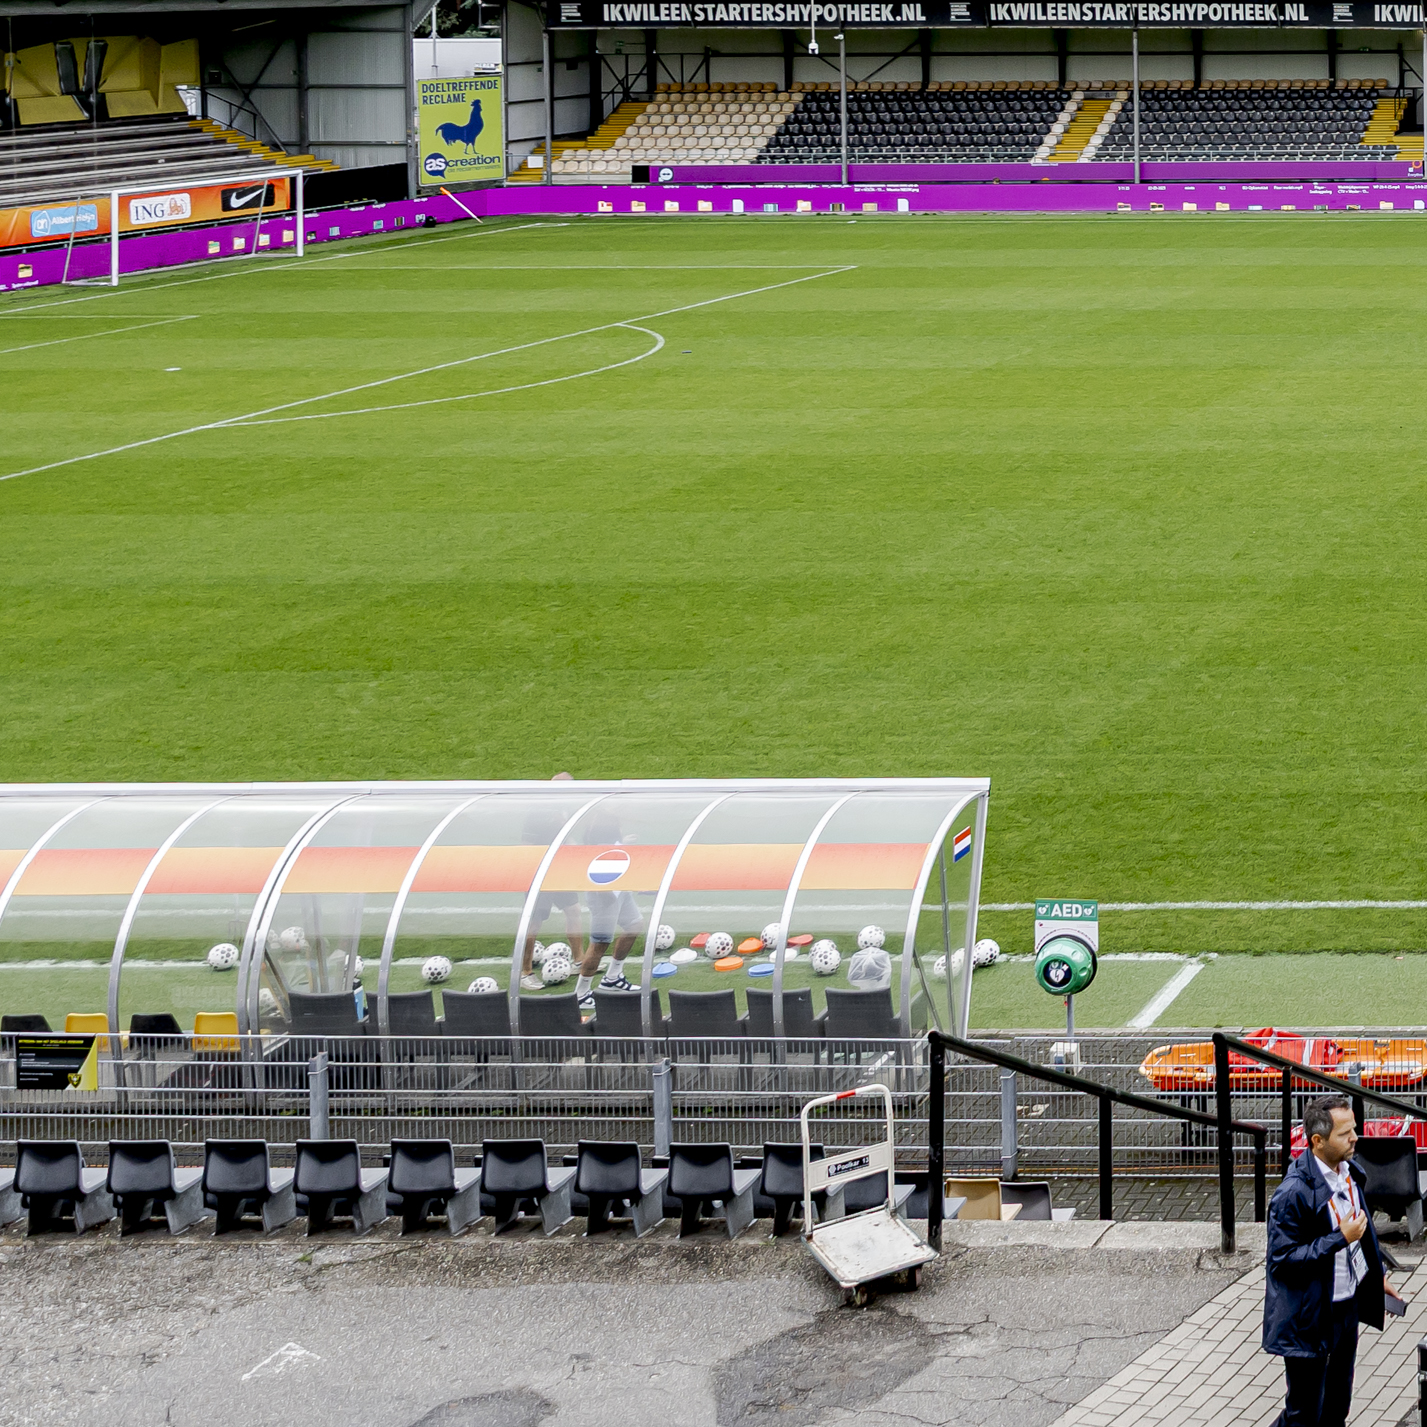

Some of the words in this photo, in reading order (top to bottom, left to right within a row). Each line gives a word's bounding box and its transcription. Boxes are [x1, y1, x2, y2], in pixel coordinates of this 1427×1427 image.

[603, 3, 926, 21] IKWILEENSTARTERSHYPOTHEEK.NL
[990, 3, 1309, 21] IKWILEENSTARTERSHYPOTHEEK.NL
[421, 79, 498, 94] DOELTREFFENDE
[422, 92, 466, 105] RECLAME
[134, 202, 165, 221] ING
[51, 215, 75, 225] Albert
[1050, 903, 1083, 918] AED
